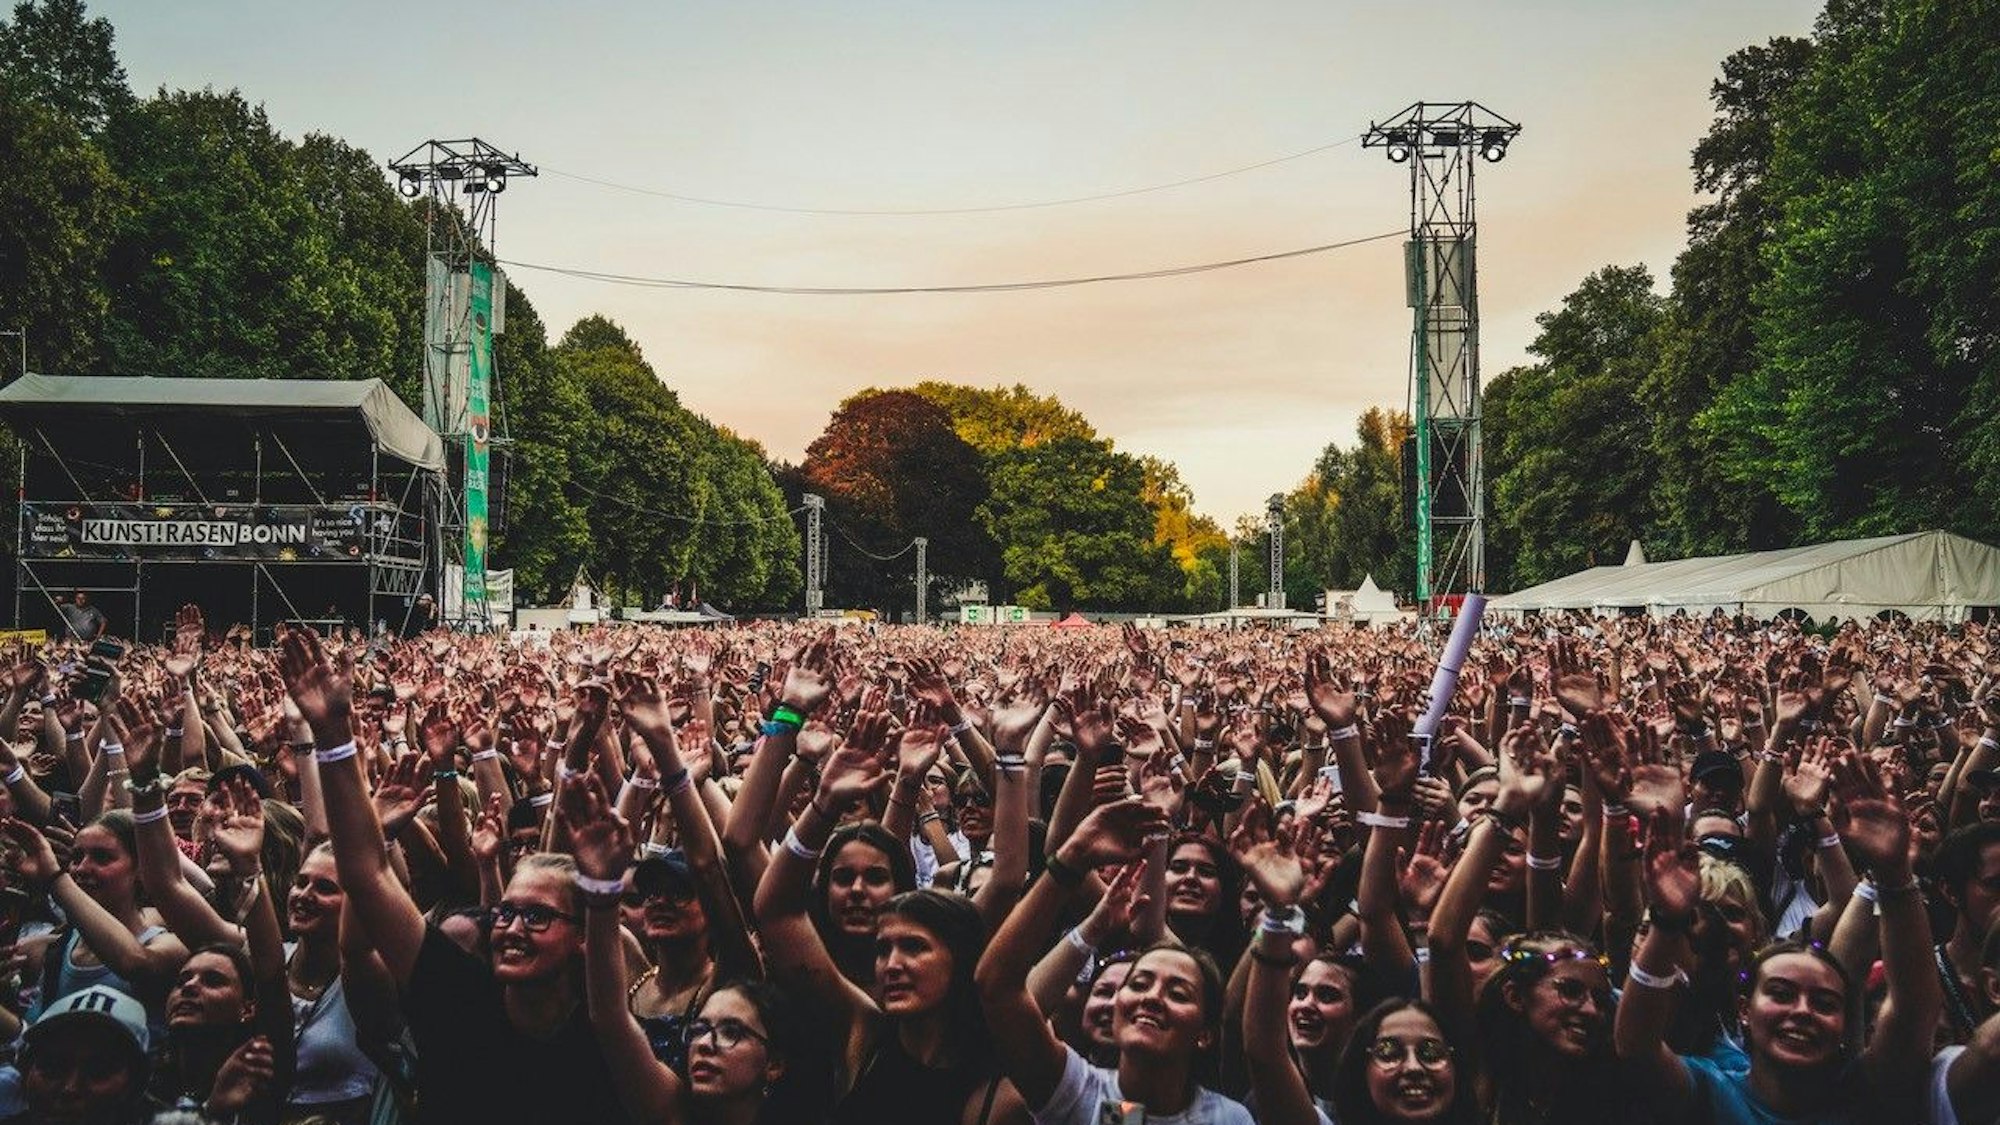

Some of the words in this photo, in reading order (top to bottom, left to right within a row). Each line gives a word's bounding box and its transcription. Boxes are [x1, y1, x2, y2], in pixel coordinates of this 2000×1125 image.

[239, 524, 306, 543] BONN
[312, 528, 338, 538] having
[339, 529, 354, 538] you
